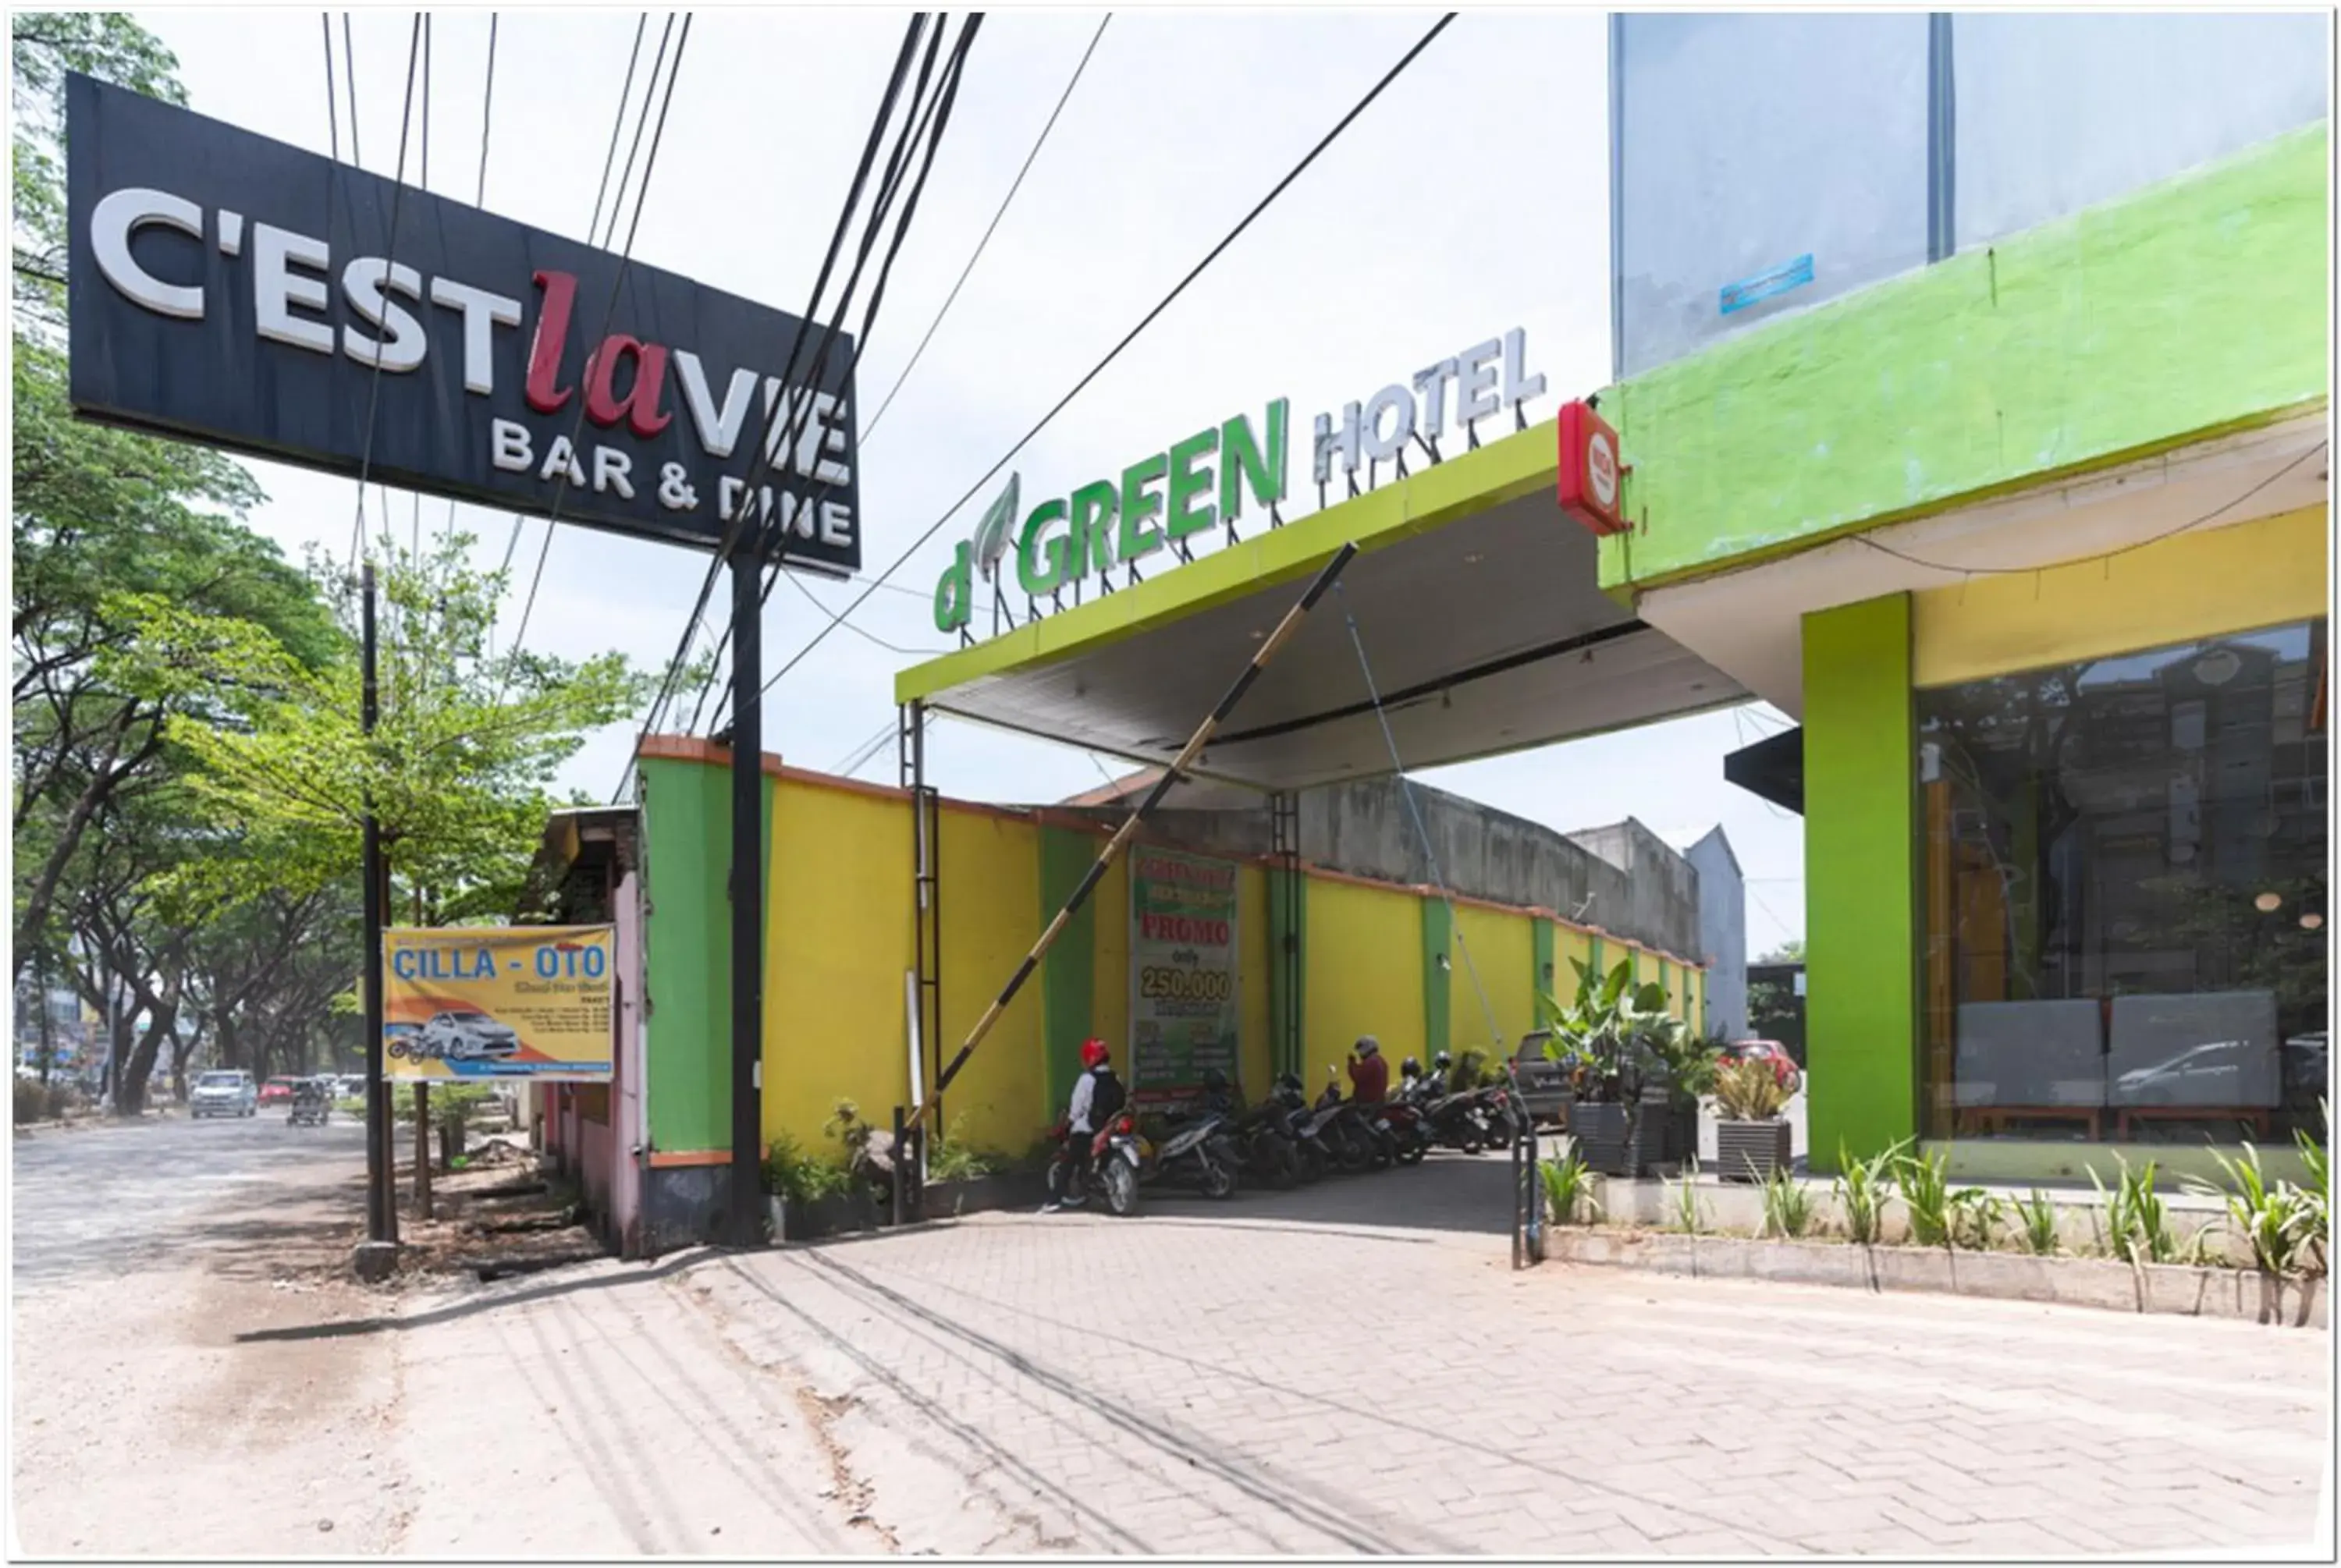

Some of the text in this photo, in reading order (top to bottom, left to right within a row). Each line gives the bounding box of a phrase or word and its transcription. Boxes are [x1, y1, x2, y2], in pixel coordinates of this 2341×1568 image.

[91, 186, 849, 488] C'EST la VIE
[1015, 397, 1290, 596] GREEN
[1313, 325, 1547, 484] HOTEL
[491, 419, 852, 548] BAR & DINE
[1139, 913, 1231, 946] PROMO
[393, 944, 606, 980] CILLA - OTO
[1172, 949, 1200, 967] only
[1140, 966, 1232, 1001] 250.000
